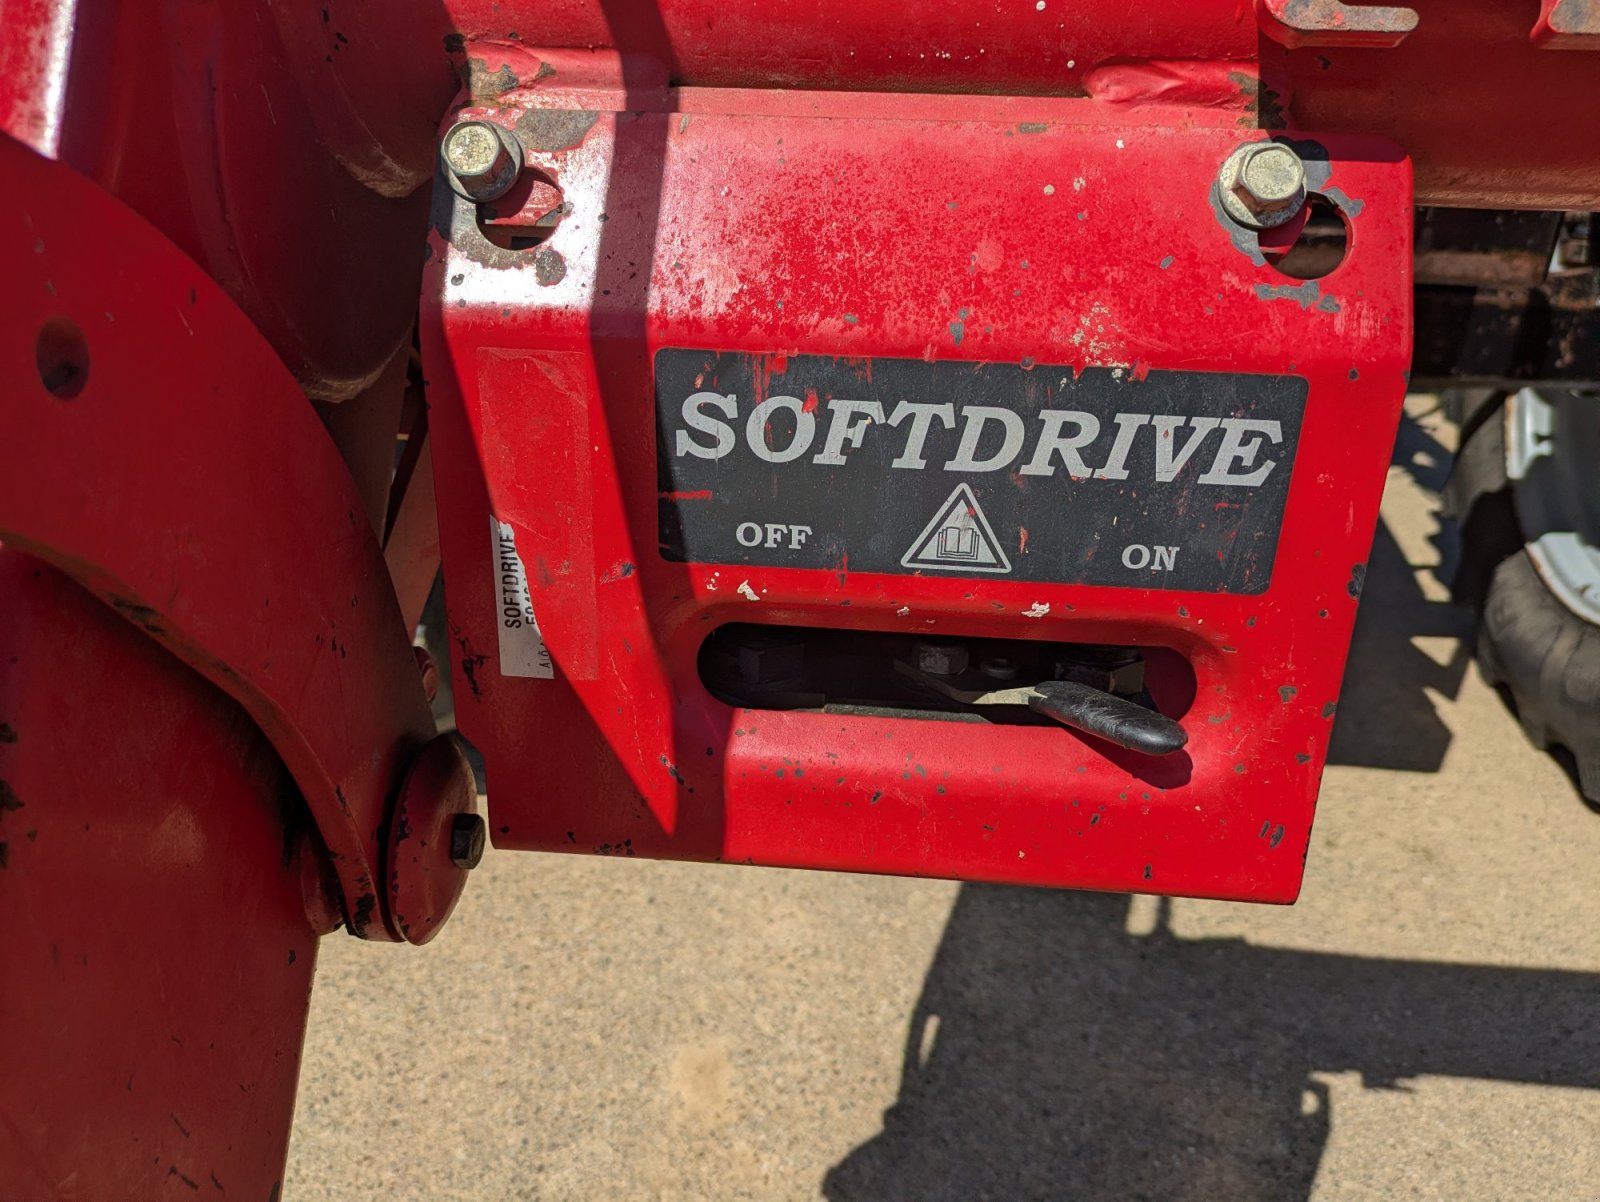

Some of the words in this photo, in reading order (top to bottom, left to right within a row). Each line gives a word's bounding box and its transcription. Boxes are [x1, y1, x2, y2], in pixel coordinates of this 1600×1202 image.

[675, 391, 1284, 487] SOFTDRIVE
[736, 521, 813, 550] OFF
[1121, 543, 1181, 571] ON
